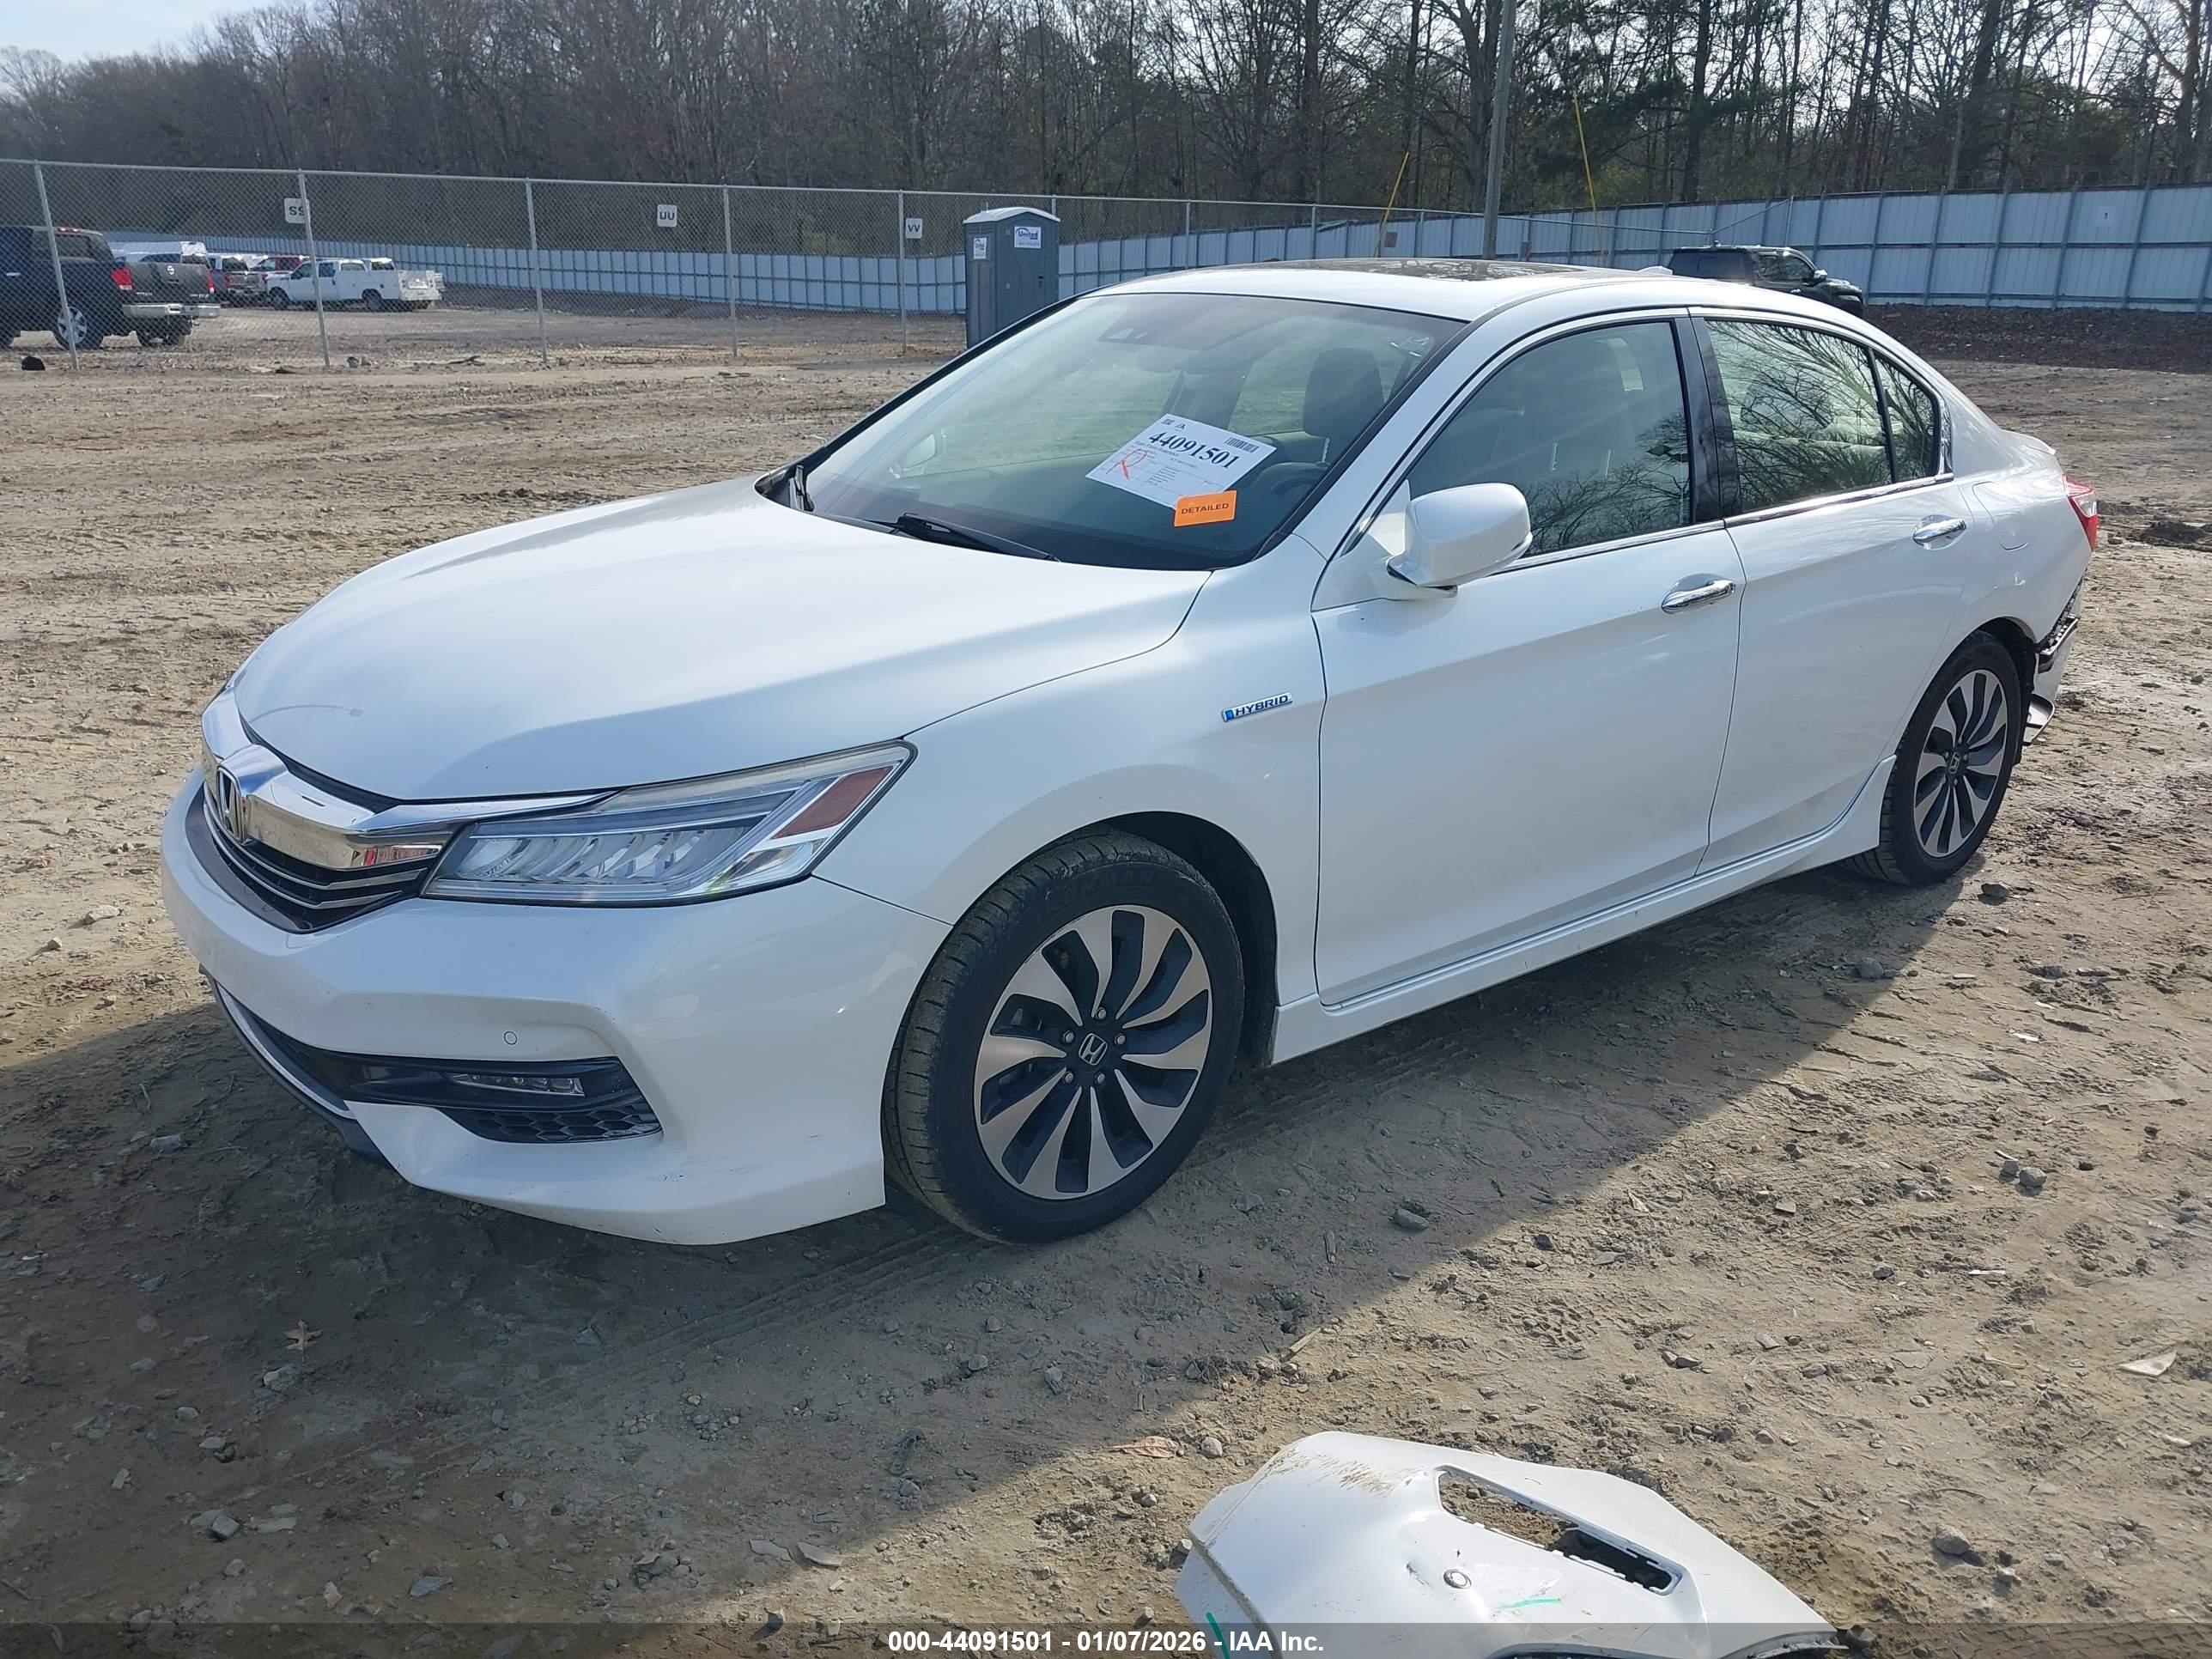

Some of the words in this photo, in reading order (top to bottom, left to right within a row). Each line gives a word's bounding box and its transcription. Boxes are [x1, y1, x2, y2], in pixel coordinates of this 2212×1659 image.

[659, 211, 675, 221] UU
[1149, 431, 1242, 470] 44091501
[1181, 502, 1230, 515] DETAILED
[1235, 695, 1289, 717] HYBRID
